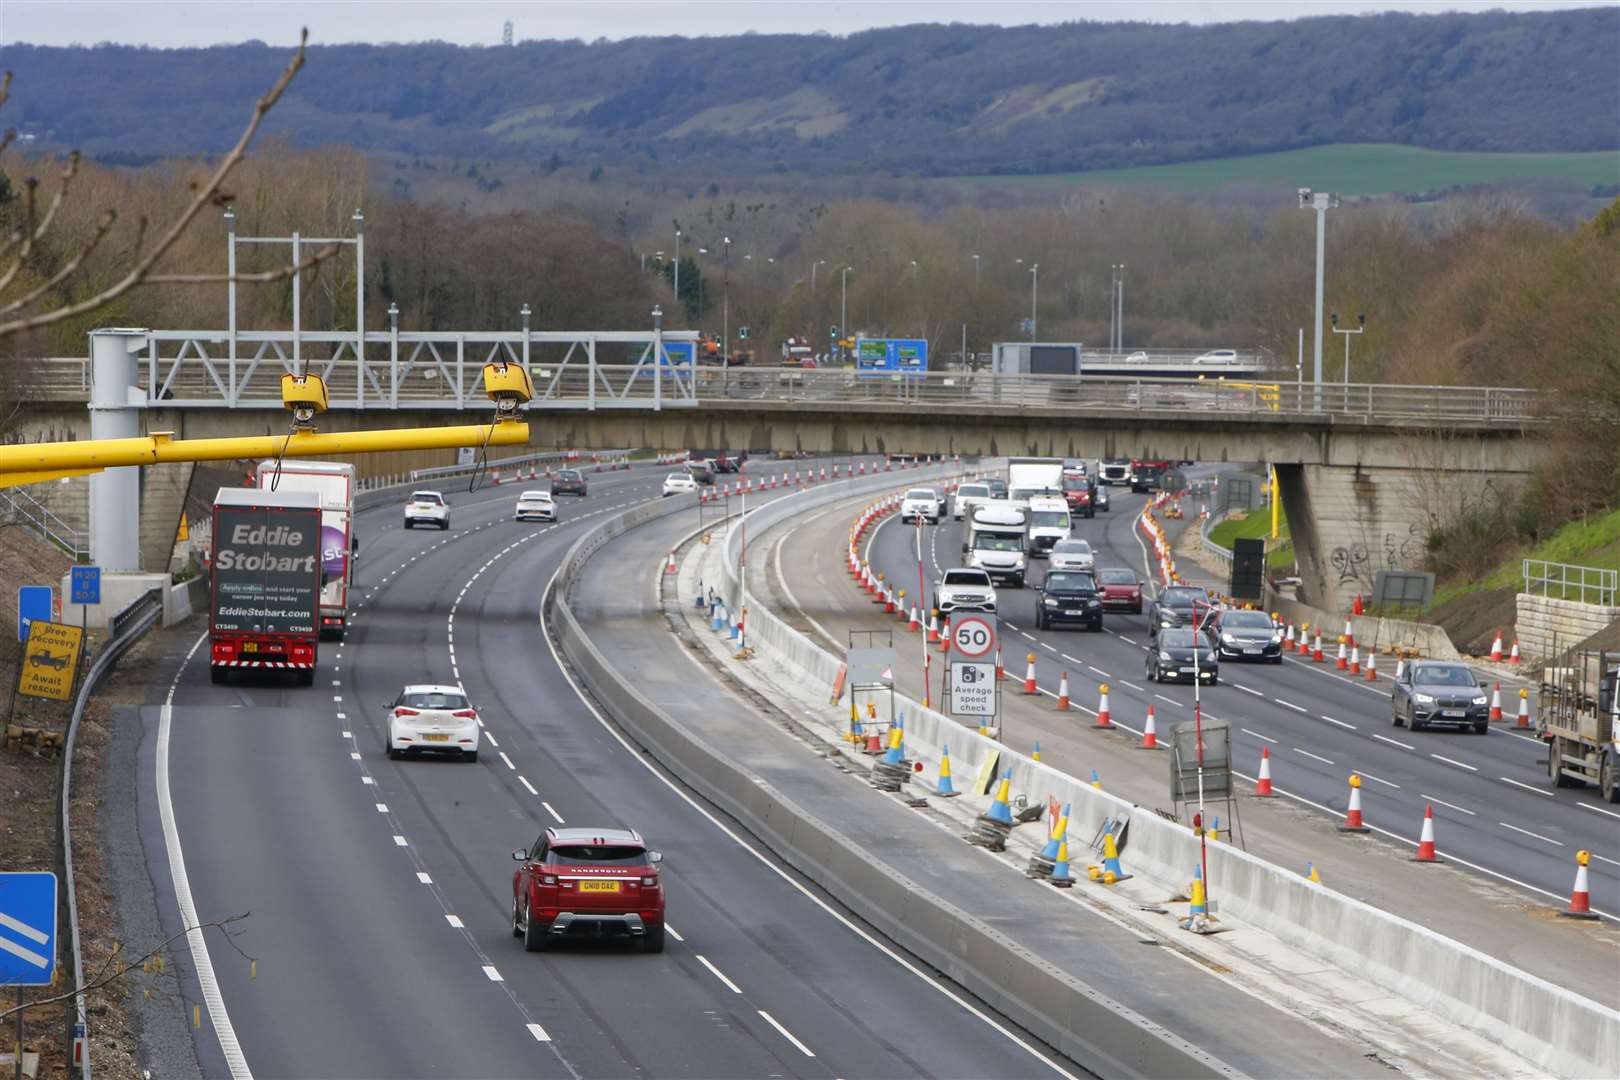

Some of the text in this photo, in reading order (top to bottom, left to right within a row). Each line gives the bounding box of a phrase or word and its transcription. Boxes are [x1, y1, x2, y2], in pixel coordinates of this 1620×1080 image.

[232, 525, 302, 545] Eddie
[216, 550, 315, 571] Stobart
[222, 583, 242, 592] Apply
[242, 584, 263, 592] online
[219, 607, 310, 618] EddieStobart.com
[46, 625, 67, 637] Free
[32, 634, 76, 649] recovery
[958, 629, 987, 646] 50
[32, 673, 63, 686] Await
[27, 683, 62, 695] rescue
[954, 685, 993, 695] Average
[960, 695, 987, 704] speed
[960, 704, 987, 712] check
